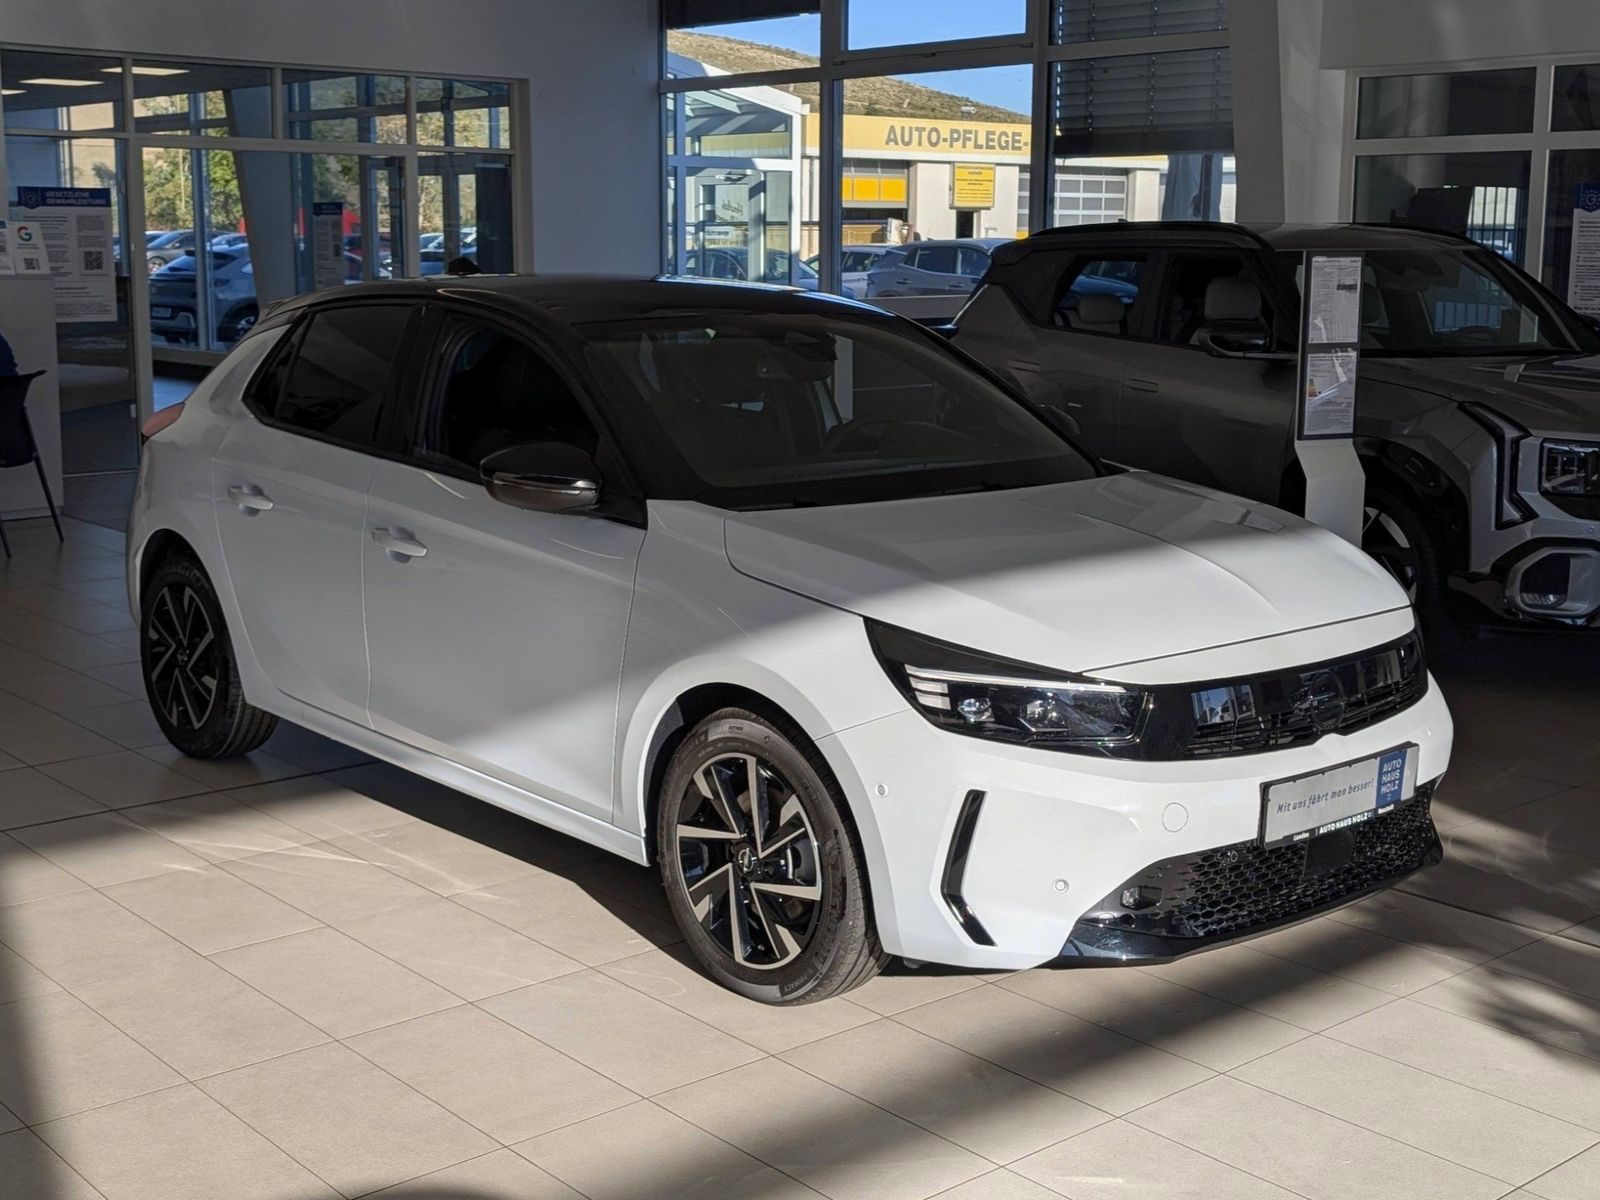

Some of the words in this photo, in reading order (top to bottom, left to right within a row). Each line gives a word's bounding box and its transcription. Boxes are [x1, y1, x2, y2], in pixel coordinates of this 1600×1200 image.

[885, 125, 1029, 151] AUTO-PFLEGE-
[1383, 759, 1401, 772] AUTO
[1382, 769, 1400, 783] HAUS
[1381, 780, 1399, 794] HOLZ
[1276, 801, 1291, 814] Mit
[1292, 799, 1306, 810] uns
[1319, 823, 1335, 833] AUTO
[1336, 818, 1351, 828] HAUS
[1352, 813, 1367, 823] HOLZ
